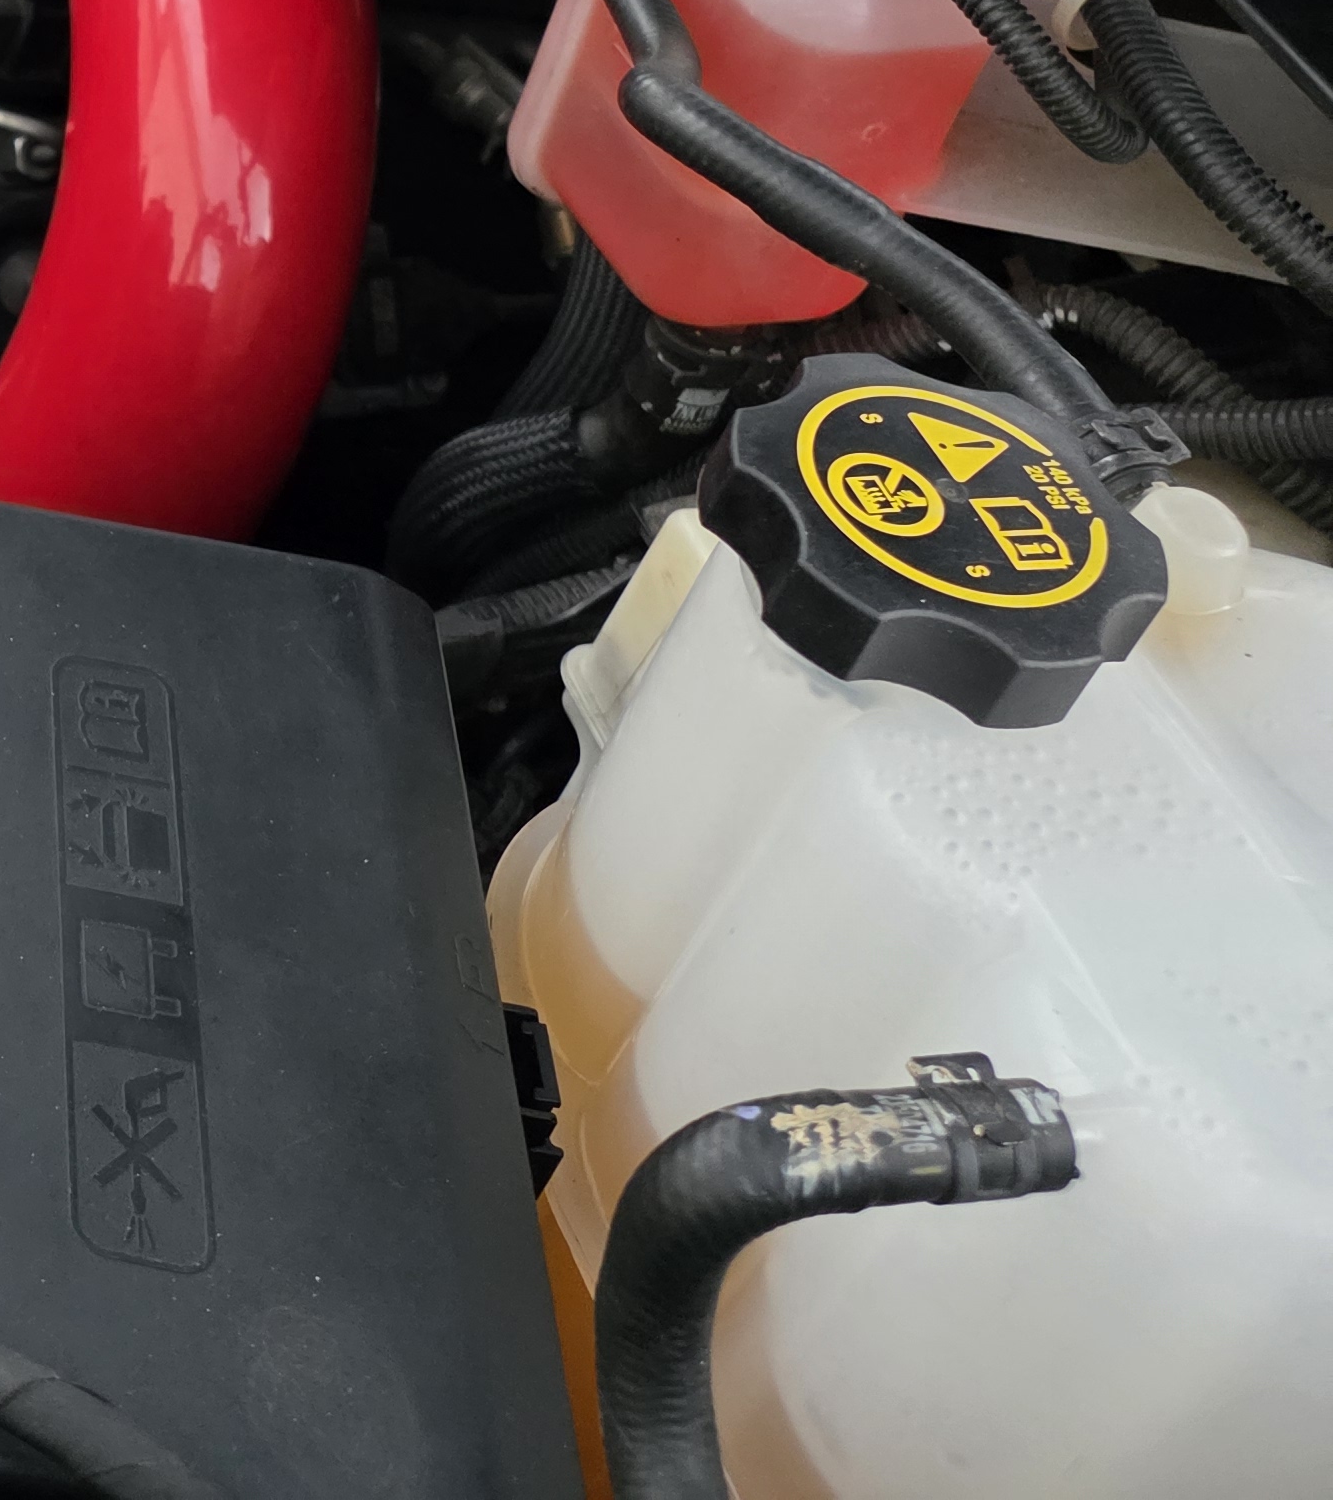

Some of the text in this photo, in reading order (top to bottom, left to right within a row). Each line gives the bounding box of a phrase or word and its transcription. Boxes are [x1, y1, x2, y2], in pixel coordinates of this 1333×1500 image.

[1022, 465, 1071, 509] 20 PSI
[1042, 459, 1073, 484] 140
